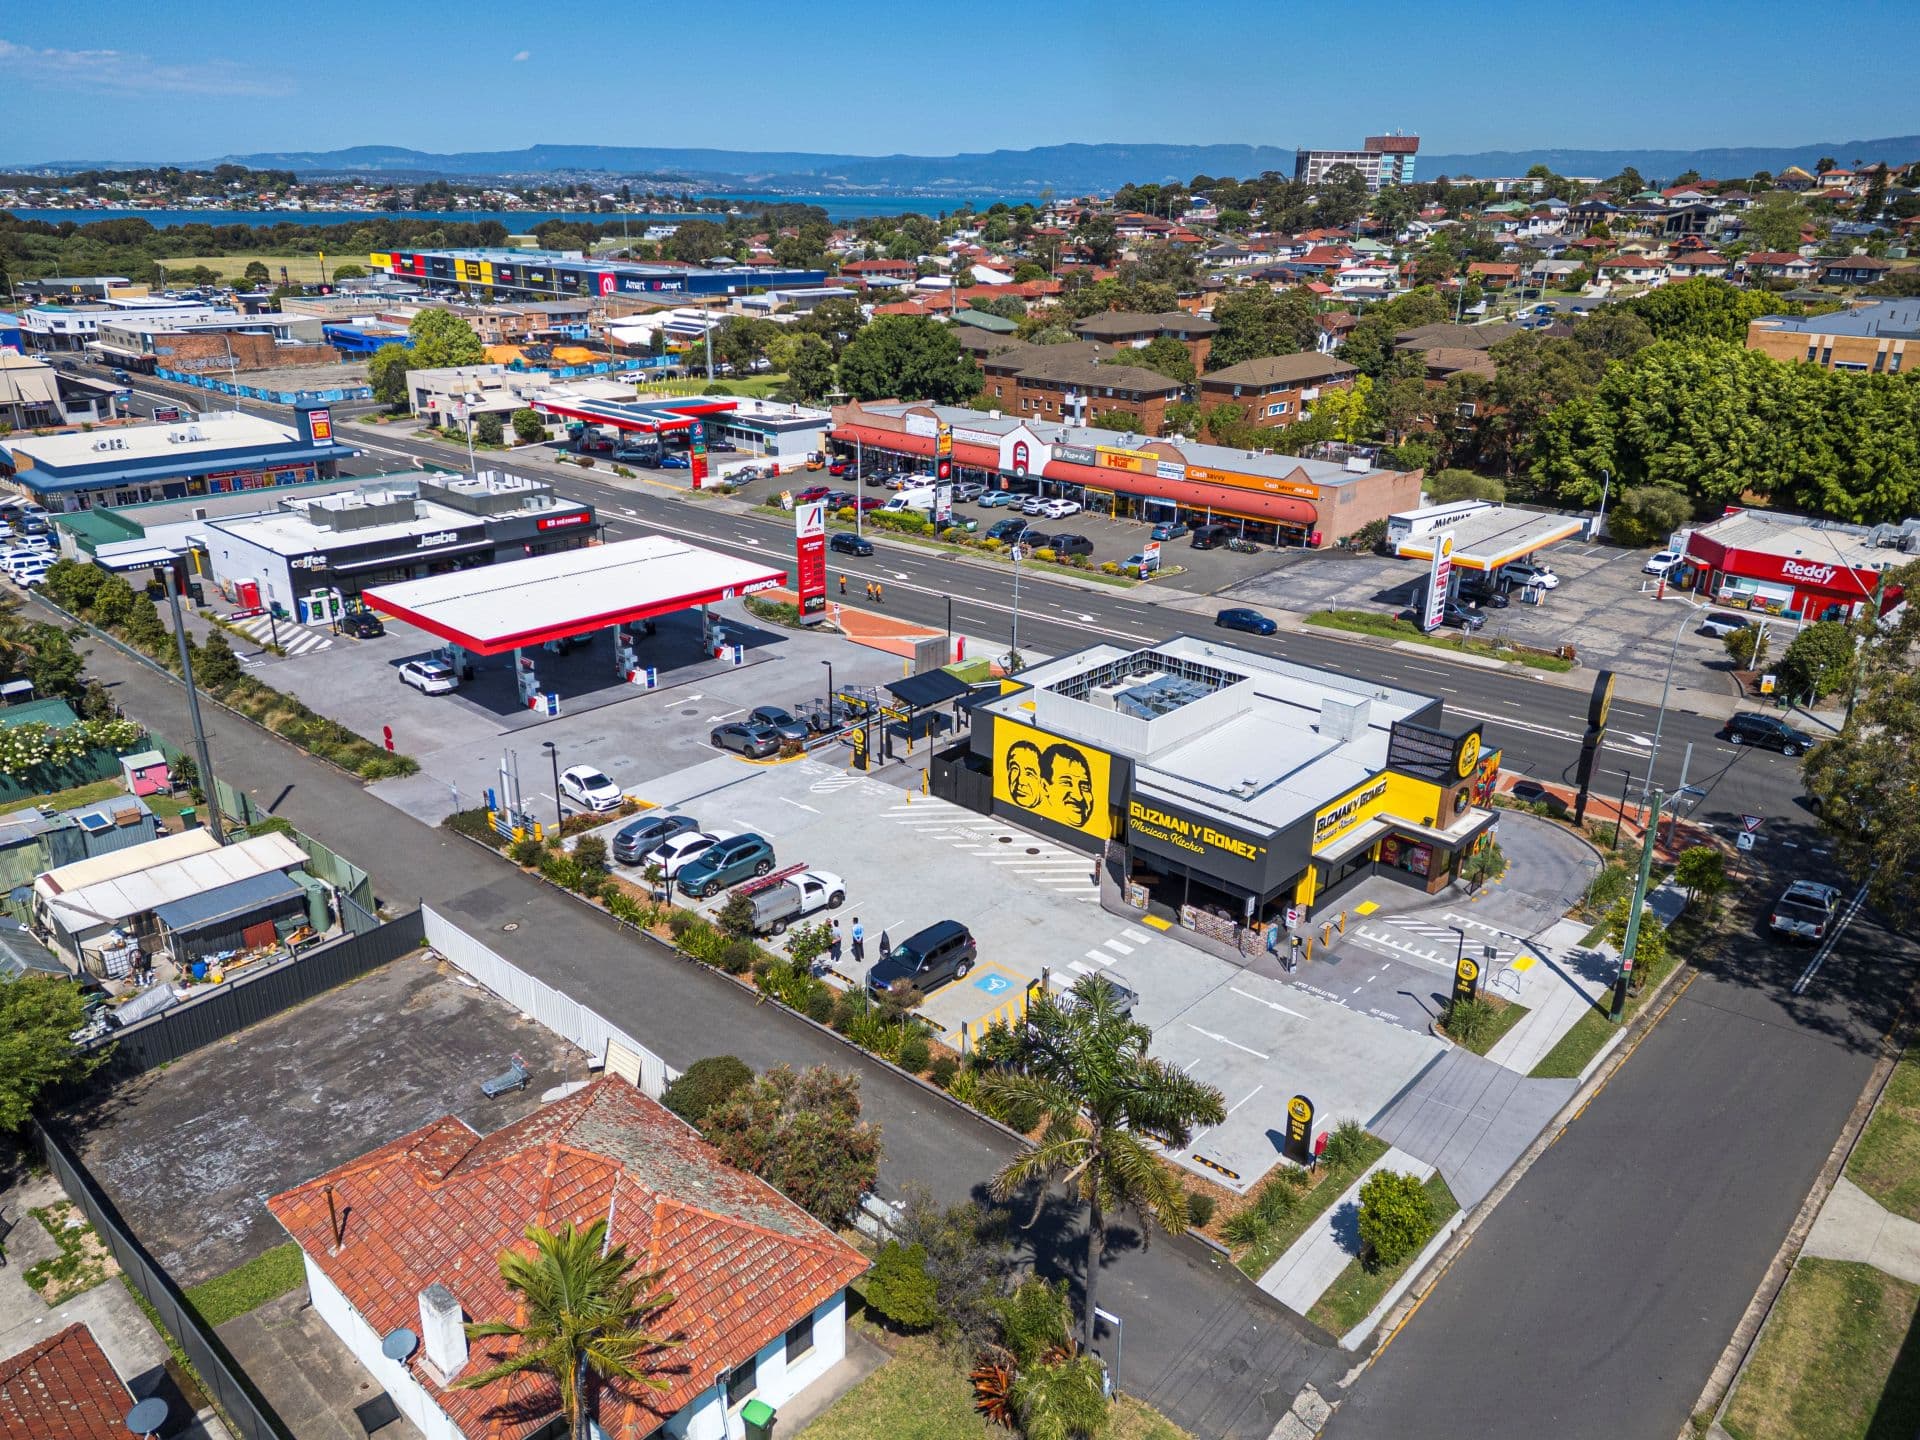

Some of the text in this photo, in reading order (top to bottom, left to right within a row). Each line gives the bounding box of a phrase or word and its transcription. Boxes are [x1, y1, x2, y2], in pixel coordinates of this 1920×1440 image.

[626, 279, 645, 290] Amart
[661, 281, 682, 289] Amart
[417, 532, 457, 548] Jasbe
[291, 555, 327, 568] coffee
[1782, 560, 1837, 584] Reddy
[742, 579, 780, 594] AMPOL
[1316, 803, 1352, 832] GUZMAN
[1130, 801, 1257, 860] GUZMAN Y GOMEZ
[1130, 819, 1206, 854] Mexican Kitchen
